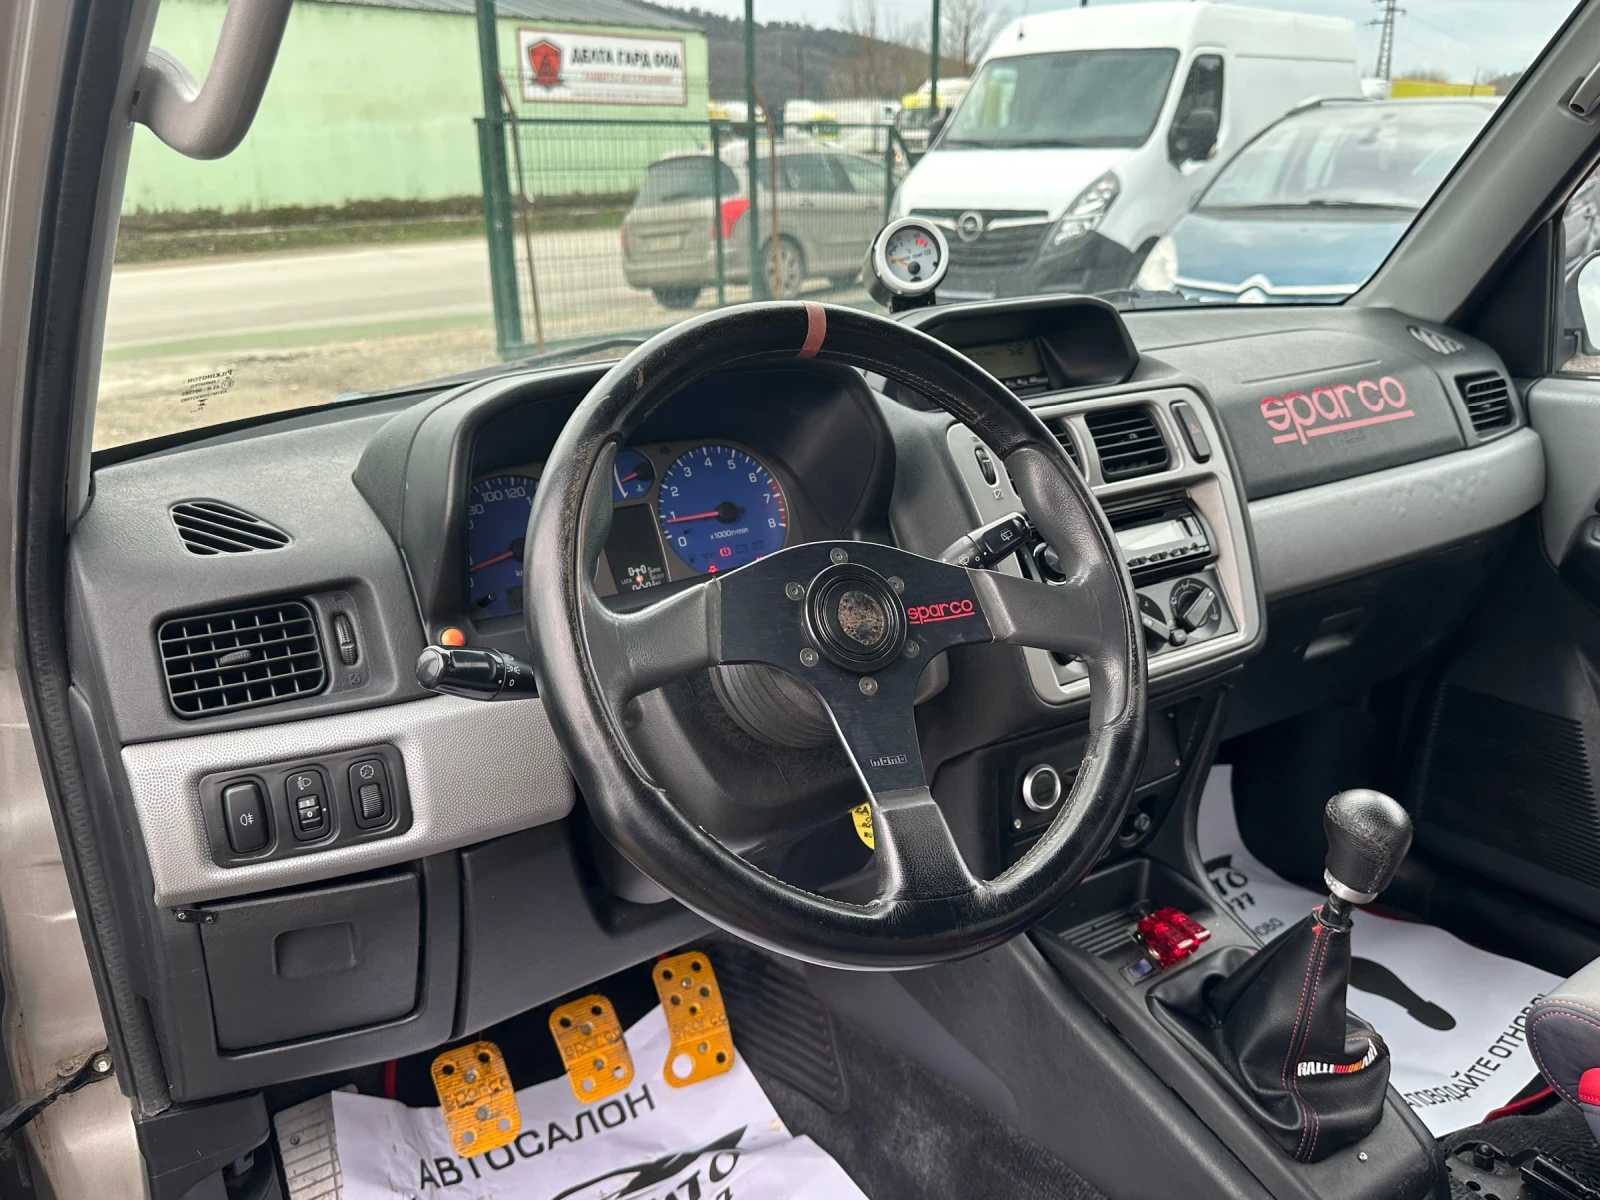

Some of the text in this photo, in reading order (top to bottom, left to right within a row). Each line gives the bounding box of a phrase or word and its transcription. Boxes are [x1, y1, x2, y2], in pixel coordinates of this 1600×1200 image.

[1260, 376, 1406, 445] sparco
[704, 457, 712, 467] 4
[727, 459, 736, 470] 5
[683, 467, 692, 477] 3
[748, 473, 757, 483] 6
[481, 490, 503, 502] 100
[504, 486, 526, 499] 120
[670, 486, 679, 497] 2
[763, 493, 770, 504] 7
[767, 518, 777, 528] 8
[677, 536, 687, 547] 0
[907, 599, 973, 624] sparco
[419, 1083, 656, 1190] АВТОСАЛОН
